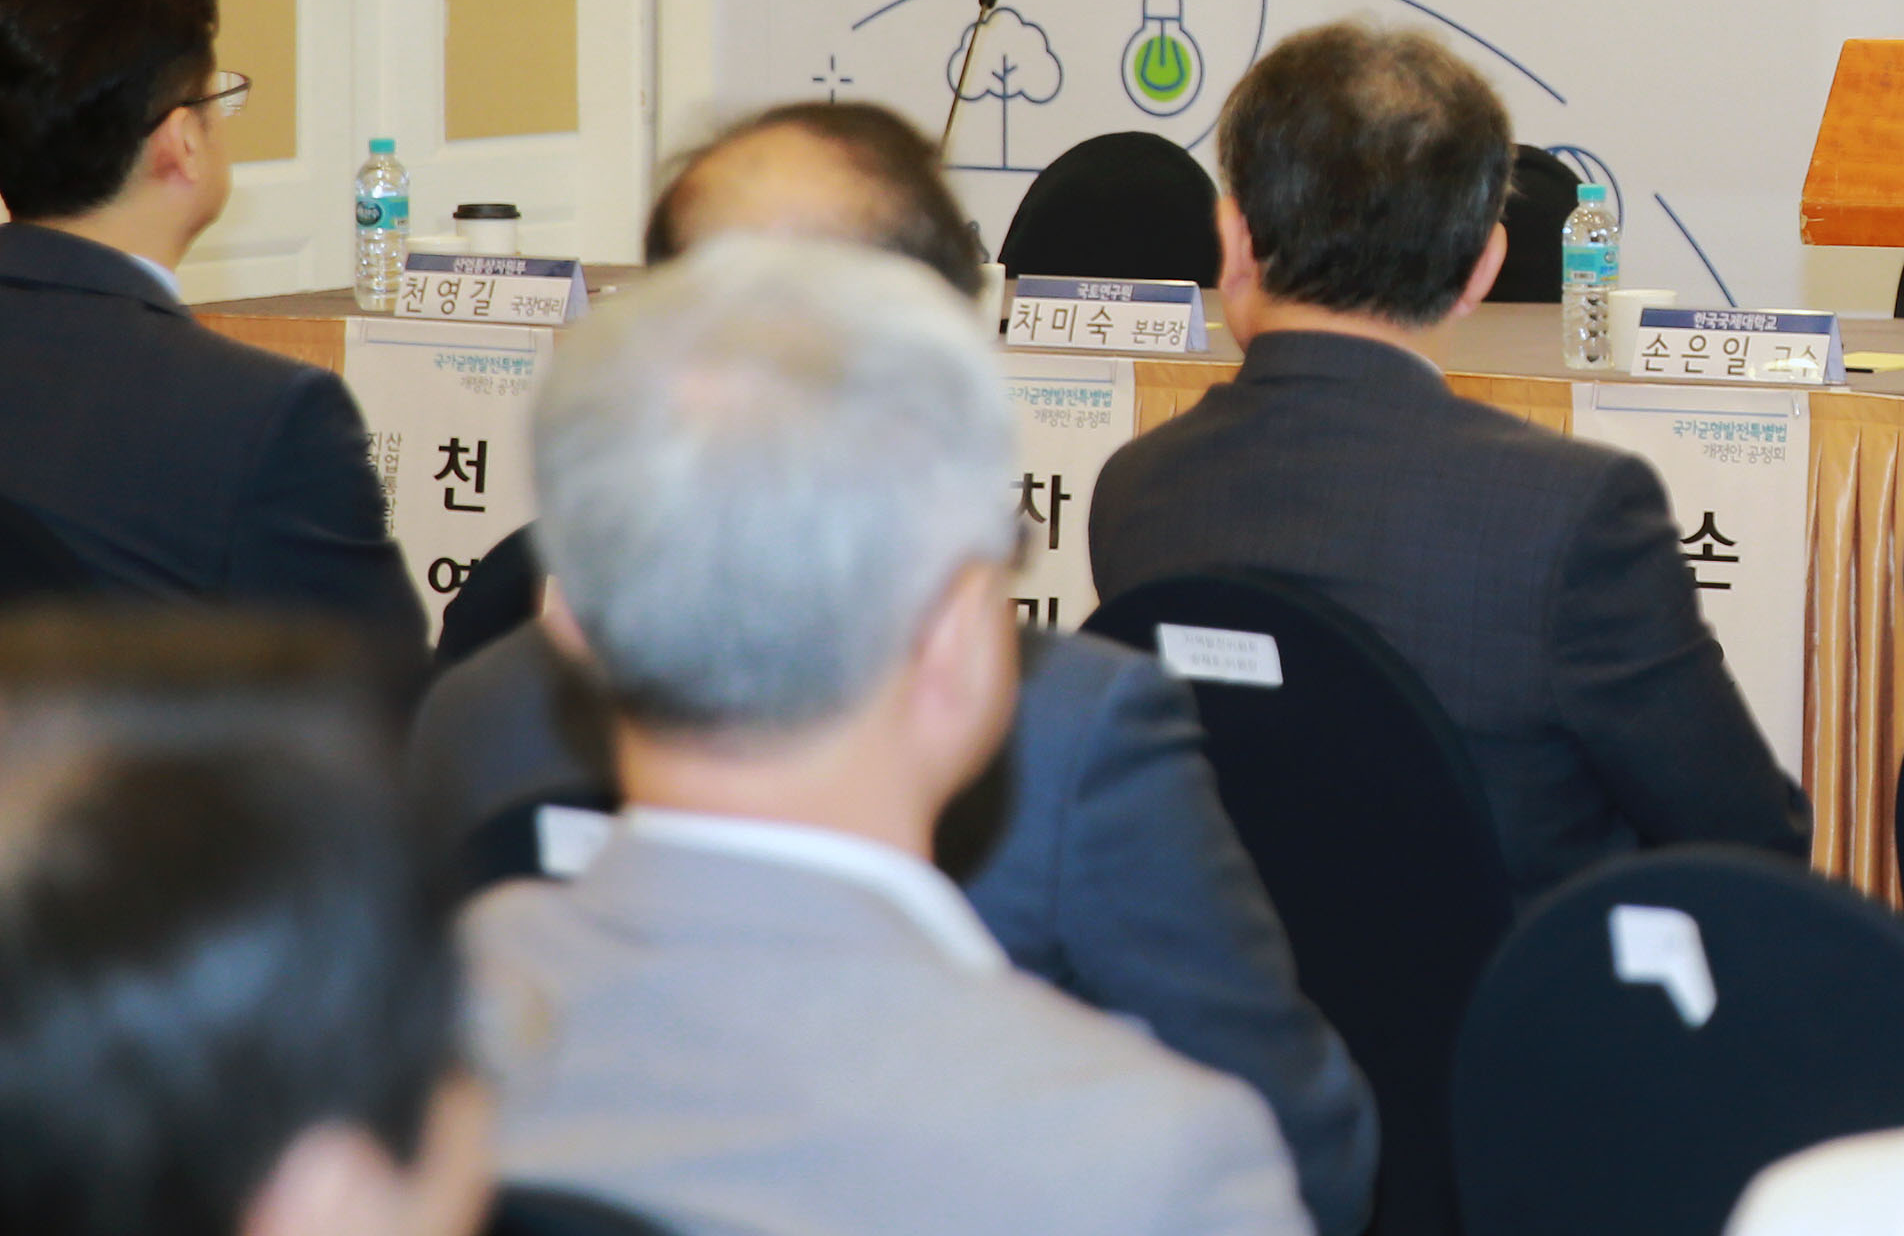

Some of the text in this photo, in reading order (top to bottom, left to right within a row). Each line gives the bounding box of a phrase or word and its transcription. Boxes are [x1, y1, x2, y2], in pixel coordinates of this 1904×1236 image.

[1076, 282, 1136, 301] 국토연구원
[510, 294, 565, 318] 국장대리
[1693, 311, 1778, 331] 한국국제대학교
[1130, 319, 1186, 346] 본부장
